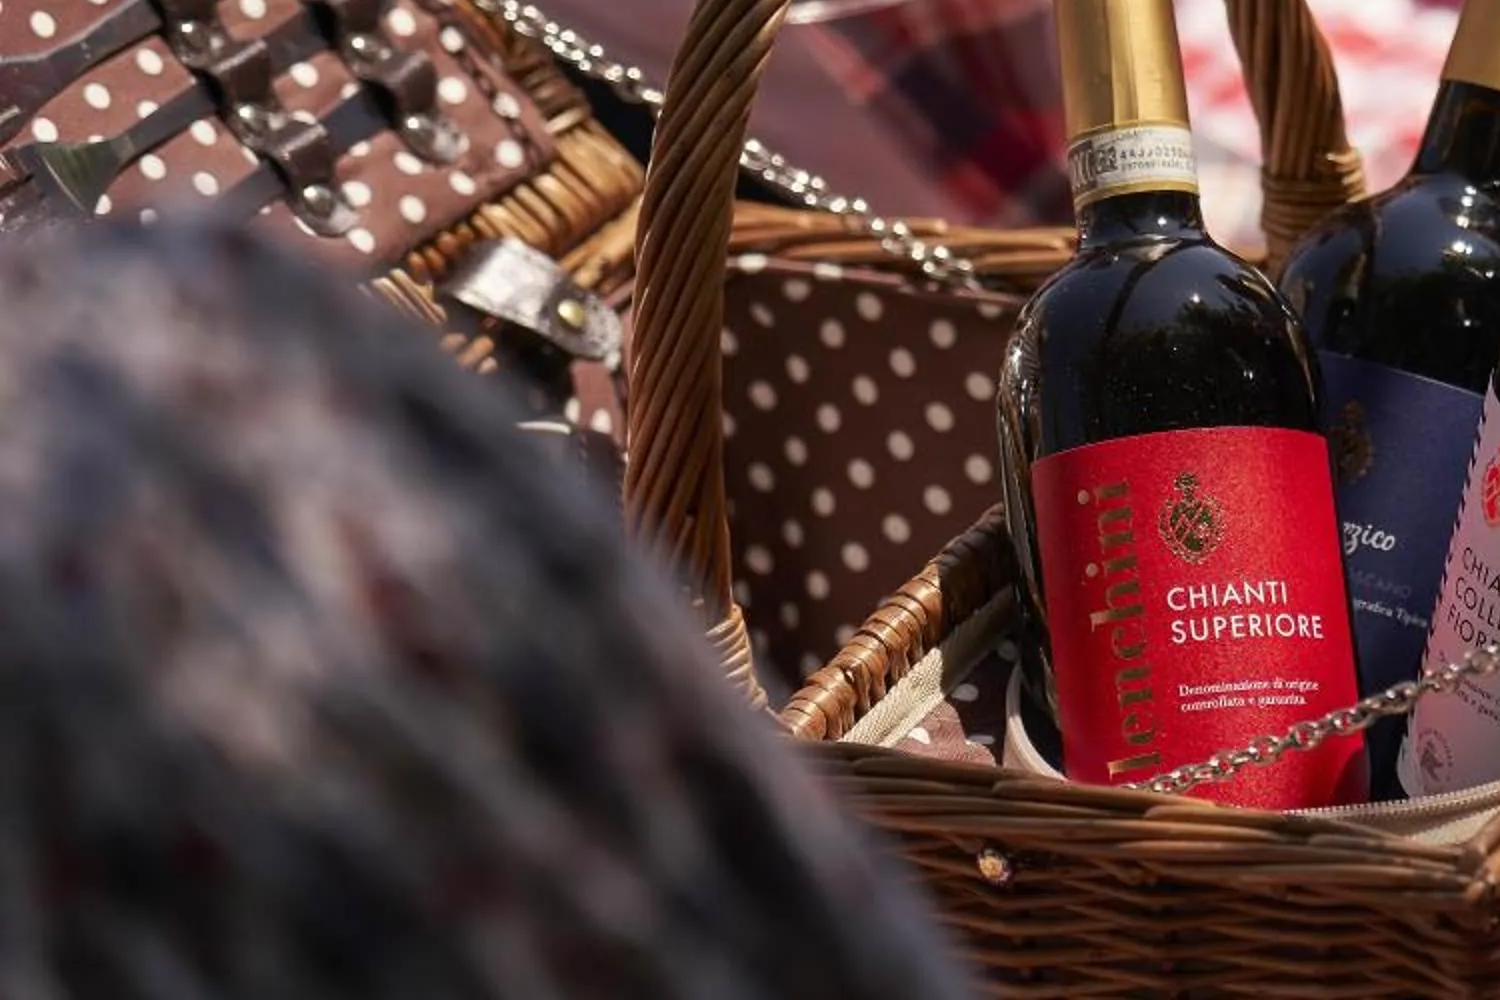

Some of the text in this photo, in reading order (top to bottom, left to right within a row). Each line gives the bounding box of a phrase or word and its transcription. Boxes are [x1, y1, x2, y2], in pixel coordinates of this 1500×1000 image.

[1167, 581, 1288, 612] CHIANTI
[1077, 478, 1162, 780] lenchini
[1171, 614, 1325, 645] SUPERIORE
